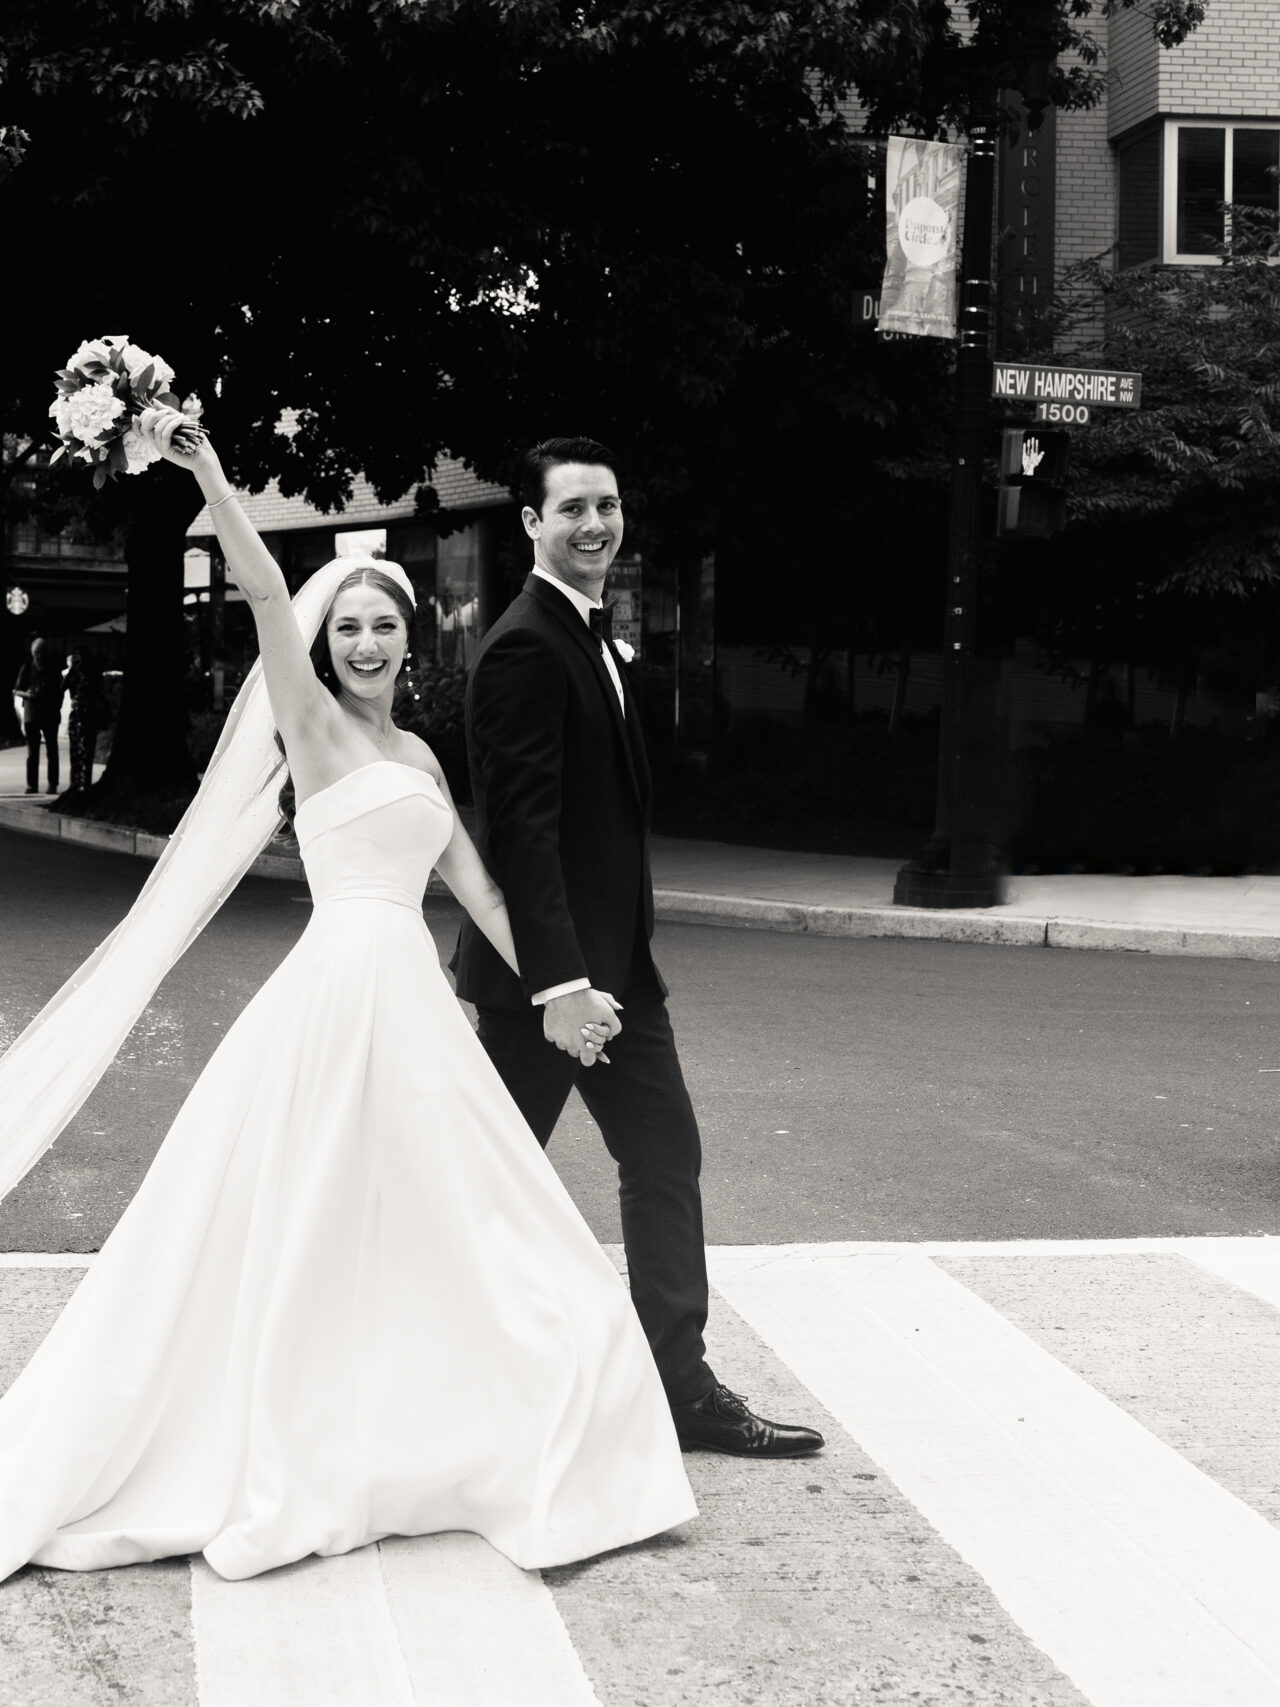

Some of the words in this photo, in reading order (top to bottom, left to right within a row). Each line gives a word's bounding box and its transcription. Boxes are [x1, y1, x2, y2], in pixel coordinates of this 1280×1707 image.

[995, 368, 1030, 396] NEW
[1034, 371, 1117, 402] HAMPSHIRE
[1120, 377, 1134, 390] AVE
[1120, 391, 1134, 403] NW
[1039, 402, 1089, 424] 1500
